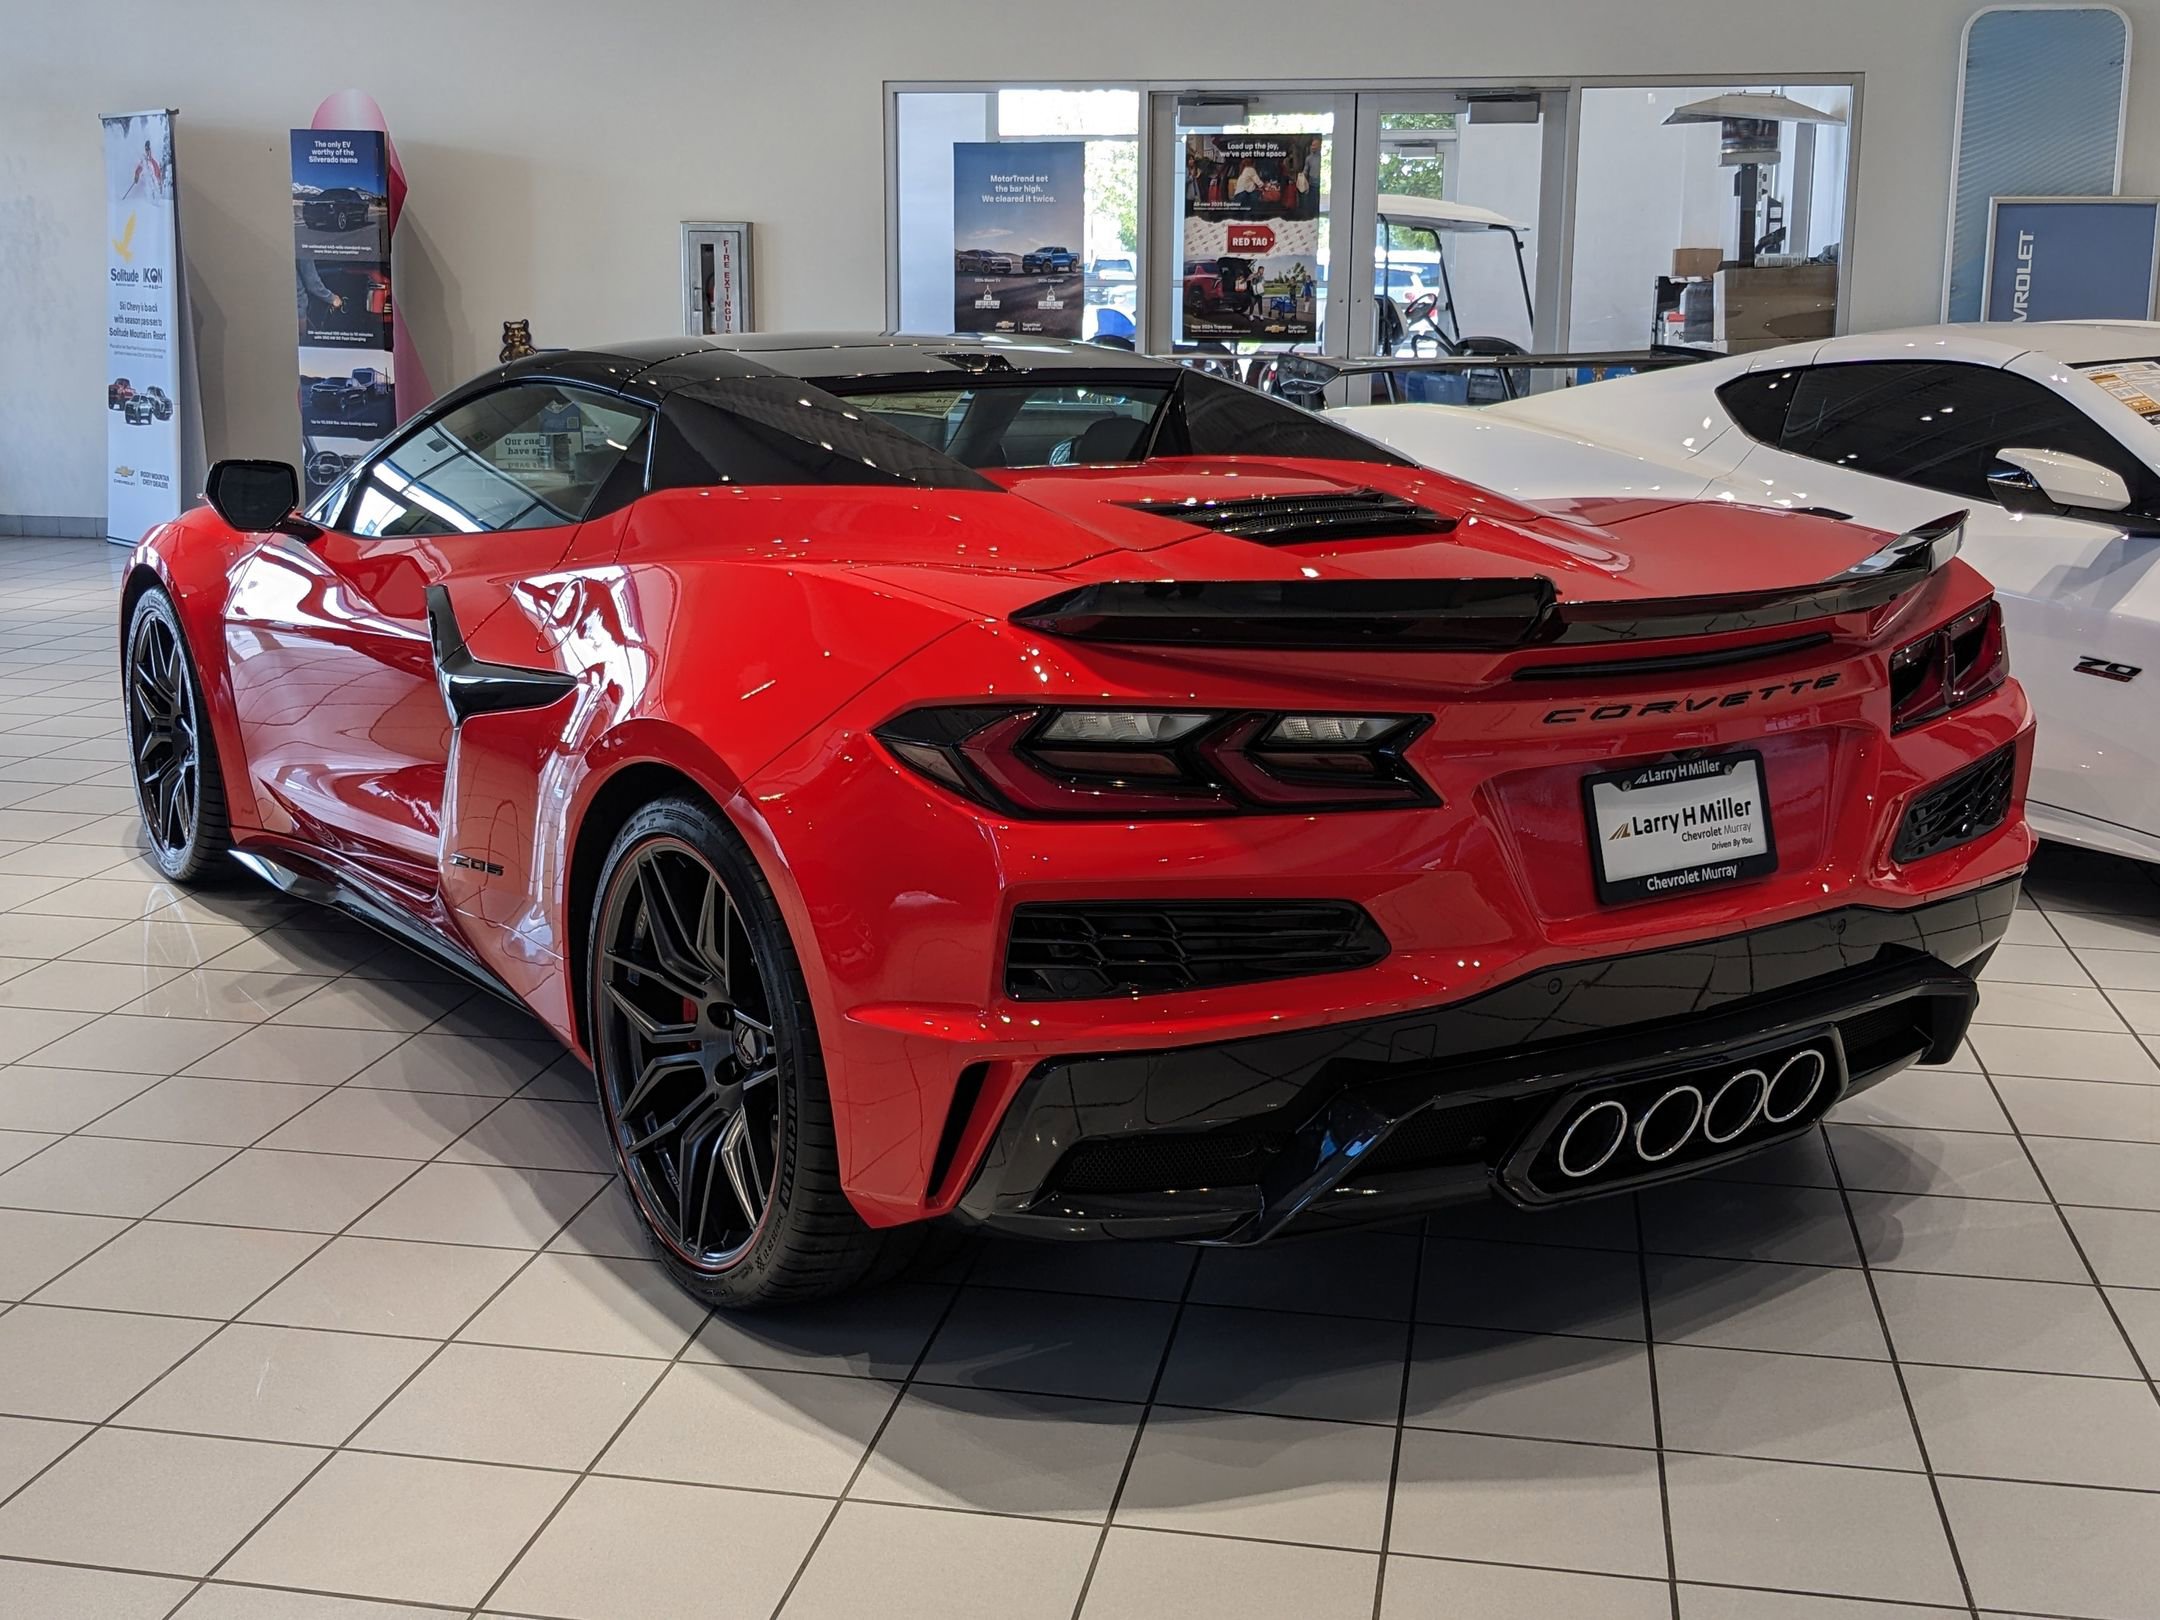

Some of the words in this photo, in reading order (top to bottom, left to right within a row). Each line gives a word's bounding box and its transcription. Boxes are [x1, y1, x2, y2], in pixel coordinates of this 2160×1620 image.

[314, 140, 326, 148] The
[327, 141, 341, 150] only
[1244, 144, 1254, 152] up
[311, 149, 334, 157] worthy
[990, 174, 1035, 182] MotorTrend
[1023, 184, 1043, 194] high.
[982, 195, 994, 203] We
[995, 195, 1025, 203] cleared
[1032, 195, 1057, 203] twice.
[1232, 237, 1250, 246] RED
[1251, 237, 1268, 246] TAG
[110, 268, 140, 282] Solitude
[504, 438, 521, 446] Our
[507, 447, 529, 455] have
[1542, 672, 1841, 725] CORVETTE
[1648, 767, 1677, 782] Larry
[1678, 764, 1688, 777] H
[1688, 759, 1720, 776] Miller
[1632, 813, 1680, 836] Larry
[1682, 806, 1697, 827] H
[1699, 797, 1752, 823] Miller
[1681, 826, 1722, 842] Chevrolet
[1723, 822, 1752, 835] Murray
[1711, 841, 1732, 851] Driven
[1732, 838, 1741, 848] By
[1646, 869, 1700, 891] Chevrolet
[1701, 864, 1737, 882] Murray
